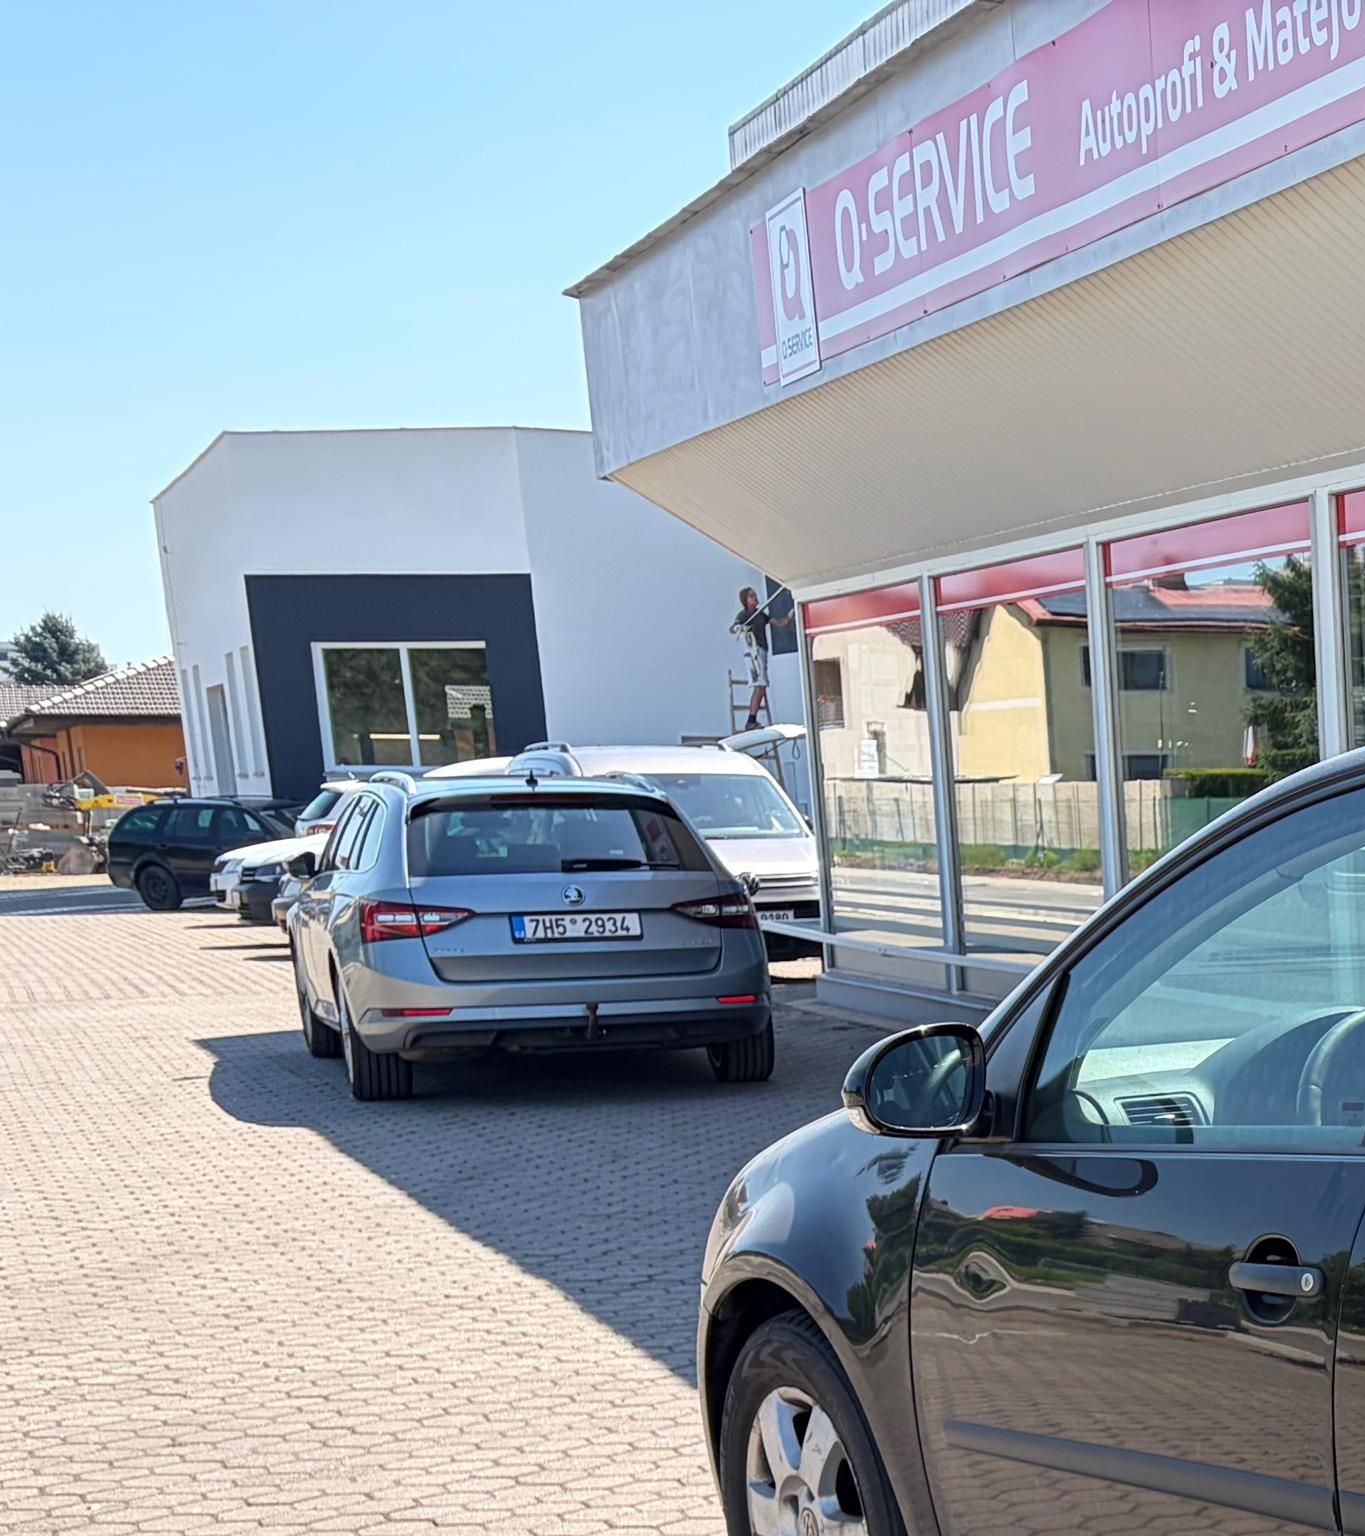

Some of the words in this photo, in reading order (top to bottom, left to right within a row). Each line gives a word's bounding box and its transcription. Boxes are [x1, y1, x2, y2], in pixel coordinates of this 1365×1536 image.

[1079, 34, 1204, 166] Autoprofi
[1212, 22, 1239, 99] &
[529, 917, 567, 938] 7H5
[583, 916, 631, 935] 2934
